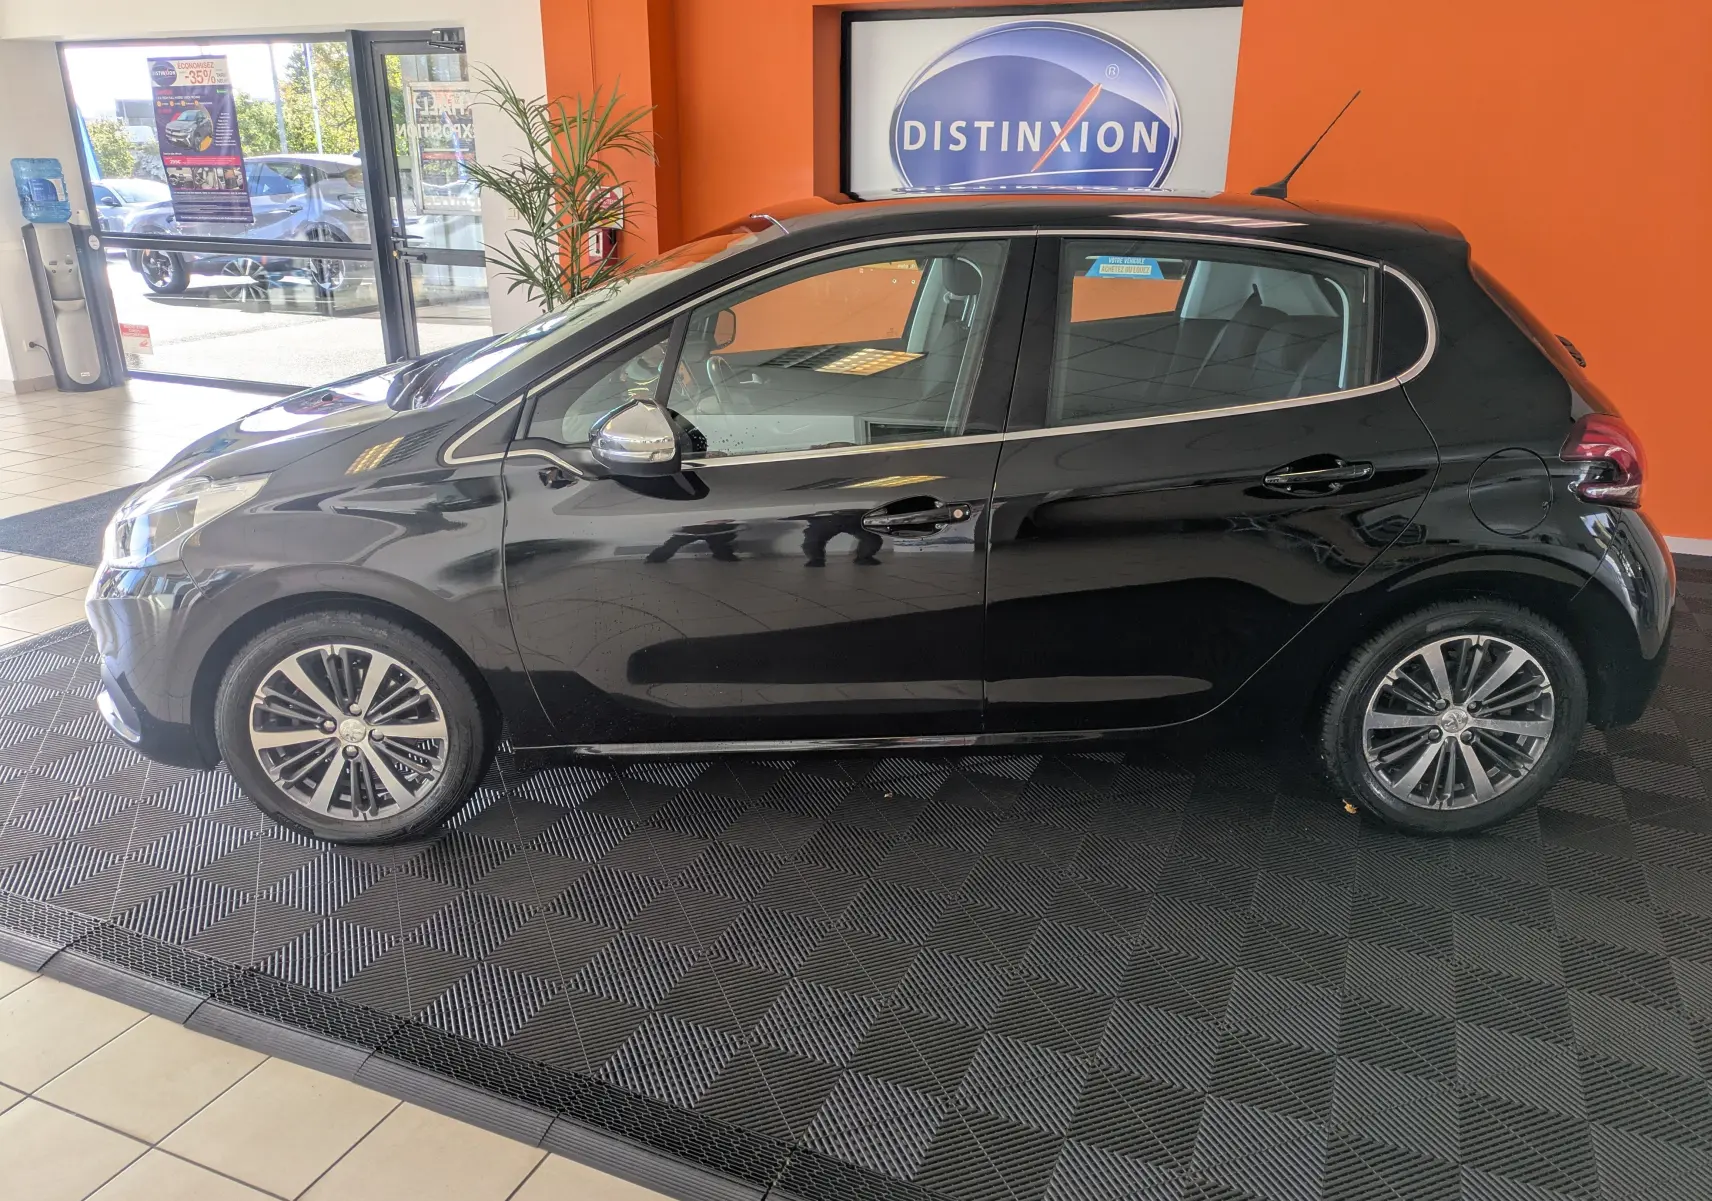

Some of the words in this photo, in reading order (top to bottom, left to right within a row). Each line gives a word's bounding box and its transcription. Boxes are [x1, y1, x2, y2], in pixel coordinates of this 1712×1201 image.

[177, 61, 214, 70] ÉCONOMISEZ
[185, 70, 216, 84] -35%
[903, 120, 1160, 154] DISTINXION
[1101, 265, 1124, 273] ACHETEZ
[1133, 266, 1150, 274] LOUEZ
